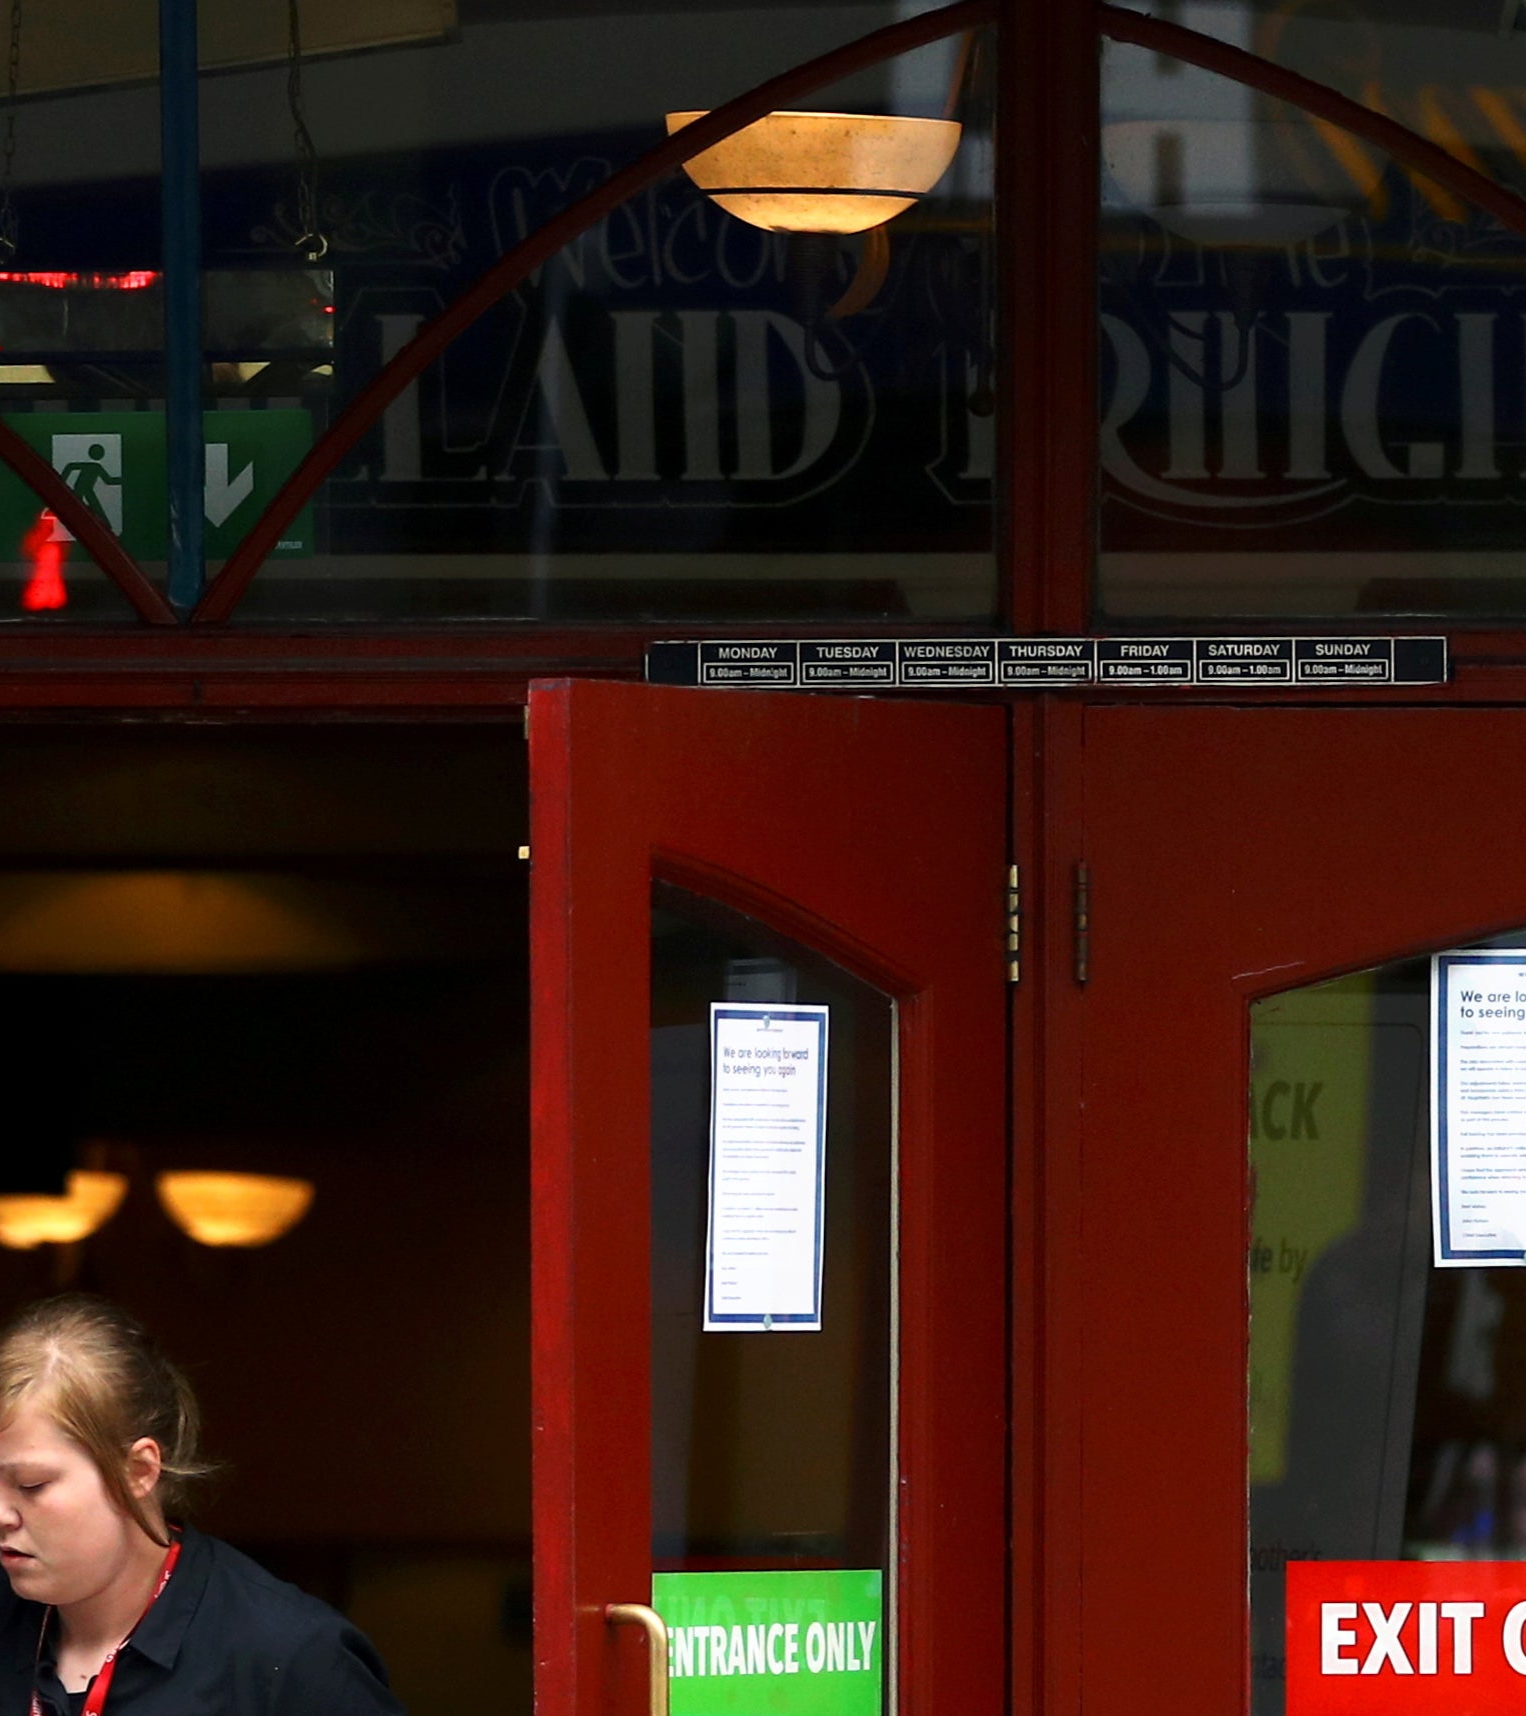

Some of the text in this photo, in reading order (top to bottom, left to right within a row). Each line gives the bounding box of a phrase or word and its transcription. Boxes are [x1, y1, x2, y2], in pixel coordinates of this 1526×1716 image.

[718, 647, 777, 660] MONDAY
[816, 646, 879, 659] TUESDAY
[904, 646, 989, 658] WEDNESDAY
[1009, 645, 1082, 658] THURSDAY
[1121, 644, 1169, 656] FRIDAY
[1208, 644, 1280, 656] SATURDAY
[1315, 644, 1371, 656] SUNDAY
[1461, 990, 1482, 1002] We
[1487, 993, 1511, 1002] are
[1461, 1006, 1474, 1018] to
[1478, 1006, 1525, 1021] seeing
[1320, 1602, 1485, 1674] EXIT
[805, 1620, 876, 1674] ONLY
